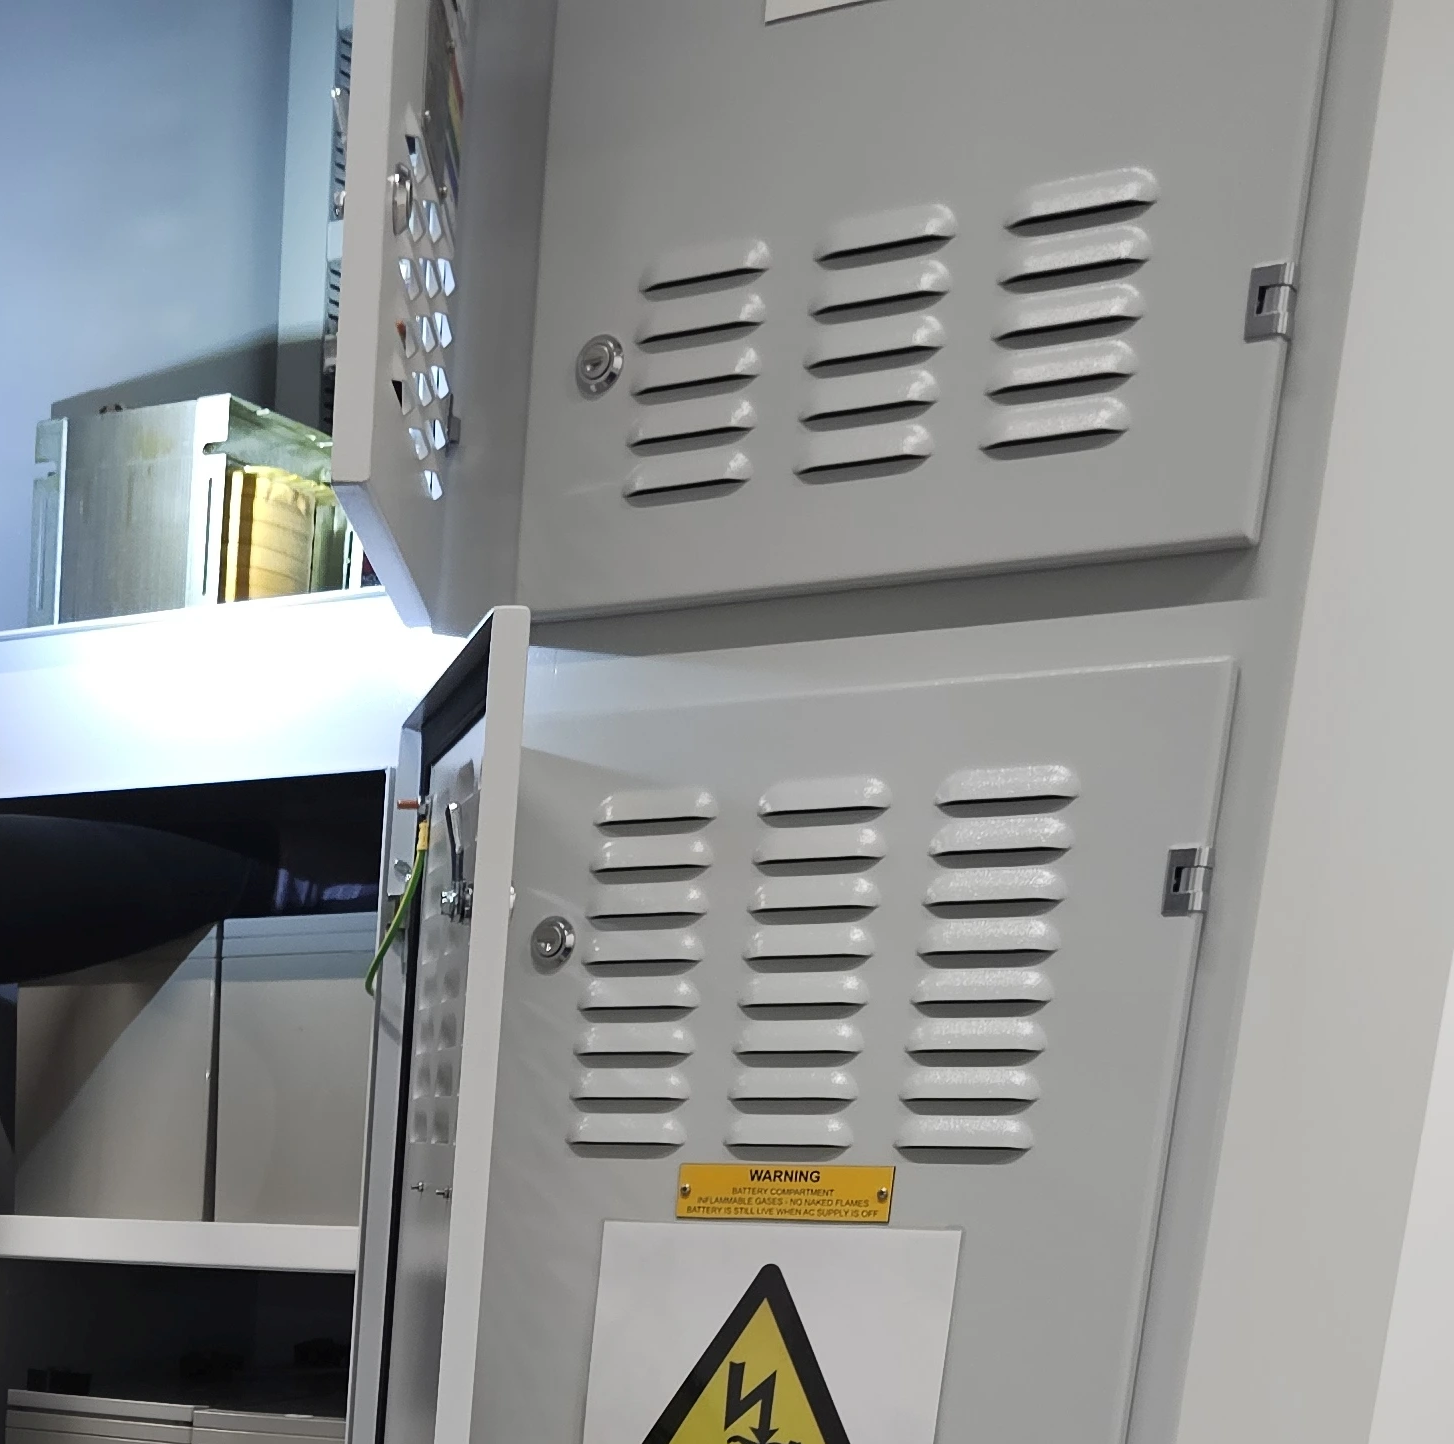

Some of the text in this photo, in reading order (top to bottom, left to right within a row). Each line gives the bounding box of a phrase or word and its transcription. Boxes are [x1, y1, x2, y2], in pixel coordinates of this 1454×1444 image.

[749, 1169, 821, 1183] WARNING
[732, 1187, 835, 1197] BATTERY COMPARTMENT
[697, 1196, 753, 1205] INFLAMMABLE
[755, 1197, 784, 1206] GASES
[789, 1198, 803, 1206] NO
[805, 1198, 834, 1207] NAKED
[835, 1199, 870, 1208] FLAMES
[686, 1206, 879, 1218] BATTERY IS STILL LIVE WHEN AC SUPPLY IS OFF
